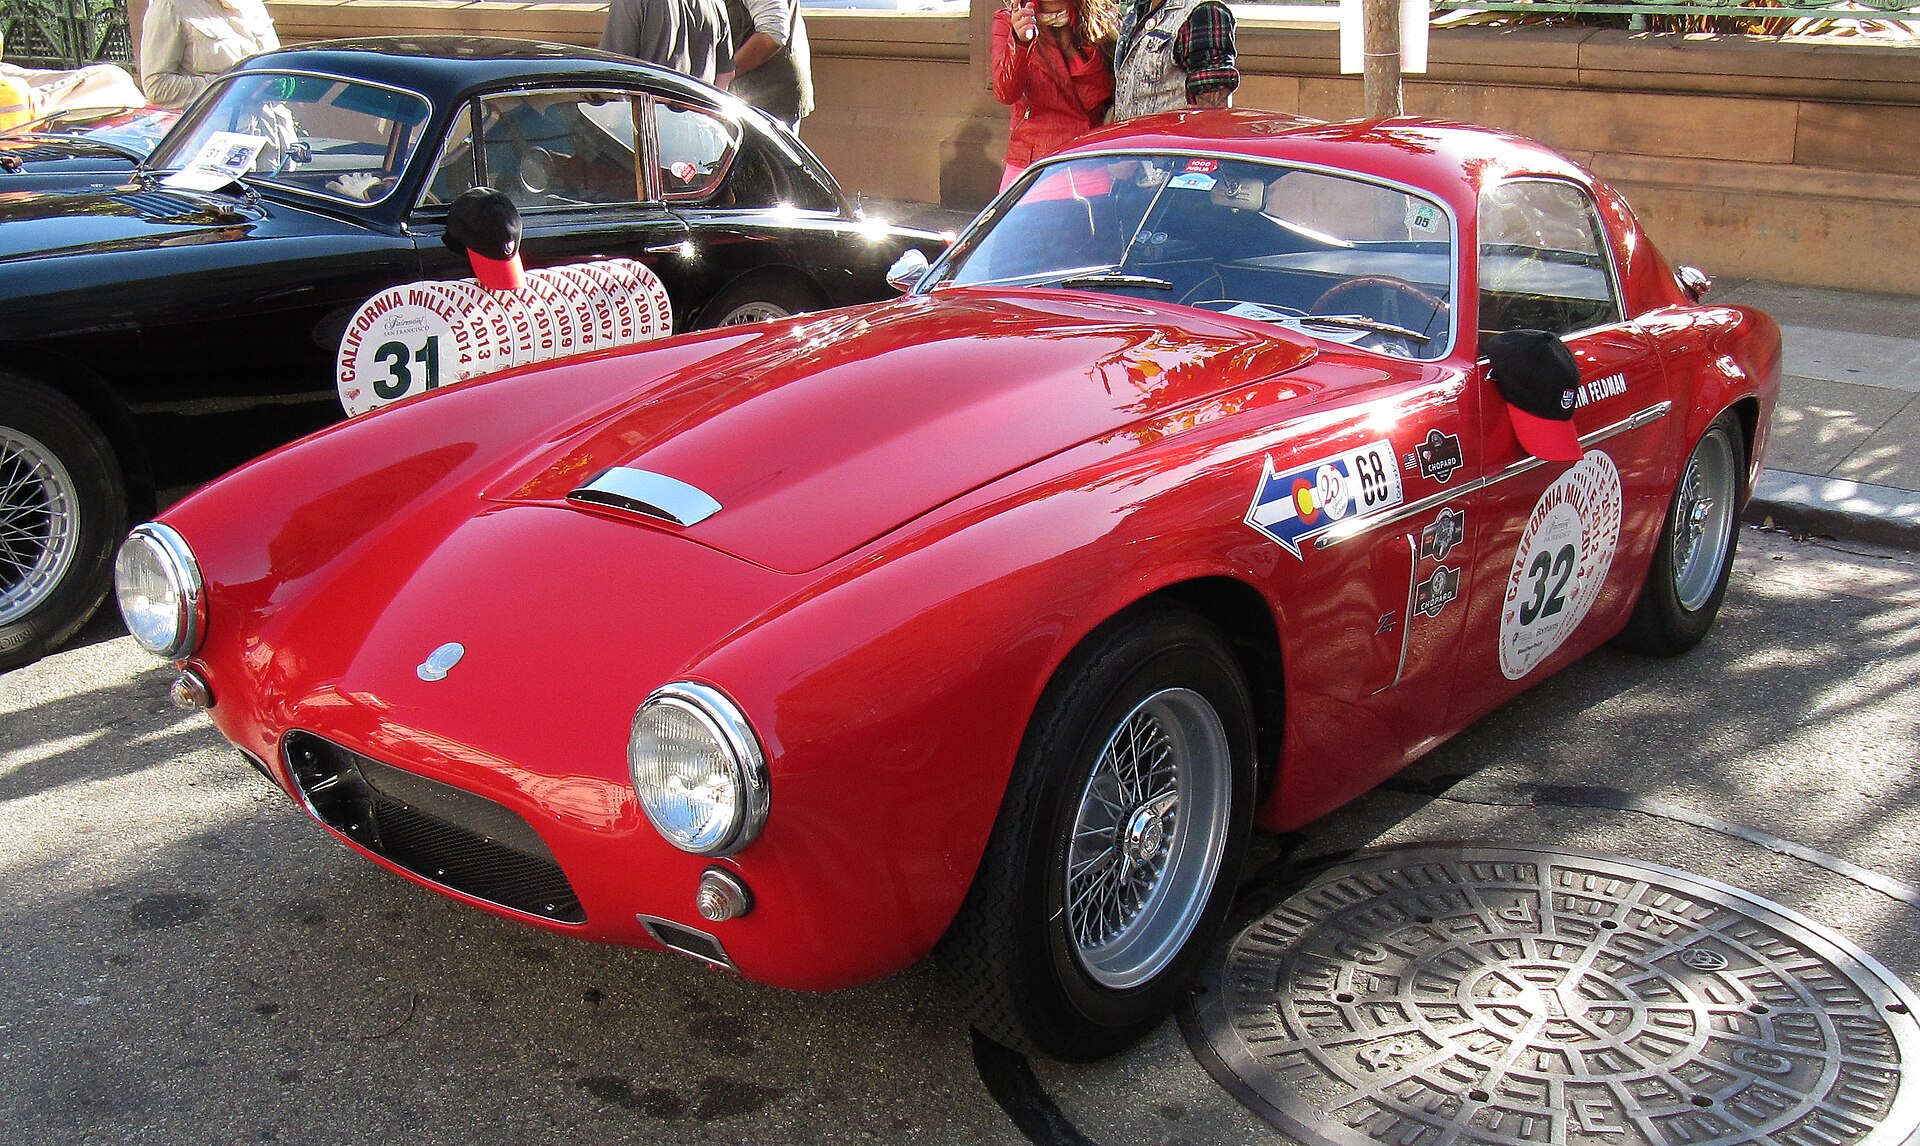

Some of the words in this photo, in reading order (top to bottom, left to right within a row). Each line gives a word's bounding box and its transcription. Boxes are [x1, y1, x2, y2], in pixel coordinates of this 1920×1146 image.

[1414, 215, 1431, 228] 05
[512, 311, 532, 351] 2011
[533, 307, 553, 349] 2010
[553, 304, 573, 348] 2009
[575, 302, 594, 344] 2008
[595, 298, 613, 340] 2007
[615, 295, 632, 338] 2006
[634, 293, 652, 335] 2005
[654, 290, 670, 332] 2004
[340, 291, 404, 382] CALIFORNIA
[408, 289, 456, 323] MILLE
[450, 320, 472, 364] 2014
[470, 316, 491, 360] 2013
[491, 314, 511, 356] 2012
[373, 335, 439, 400] 31
[1587, 372, 1627, 403] FELDMAN
[1356, 451, 1388, 506] 68
[1427, 457, 1457, 472] CHOPARD
[1507, 484, 1562, 602] CALIFORNIA
[1564, 482, 1589, 525] MILLE
[1420, 590, 1452, 611] CHOPARD
[1519, 543, 1575, 626] 32
